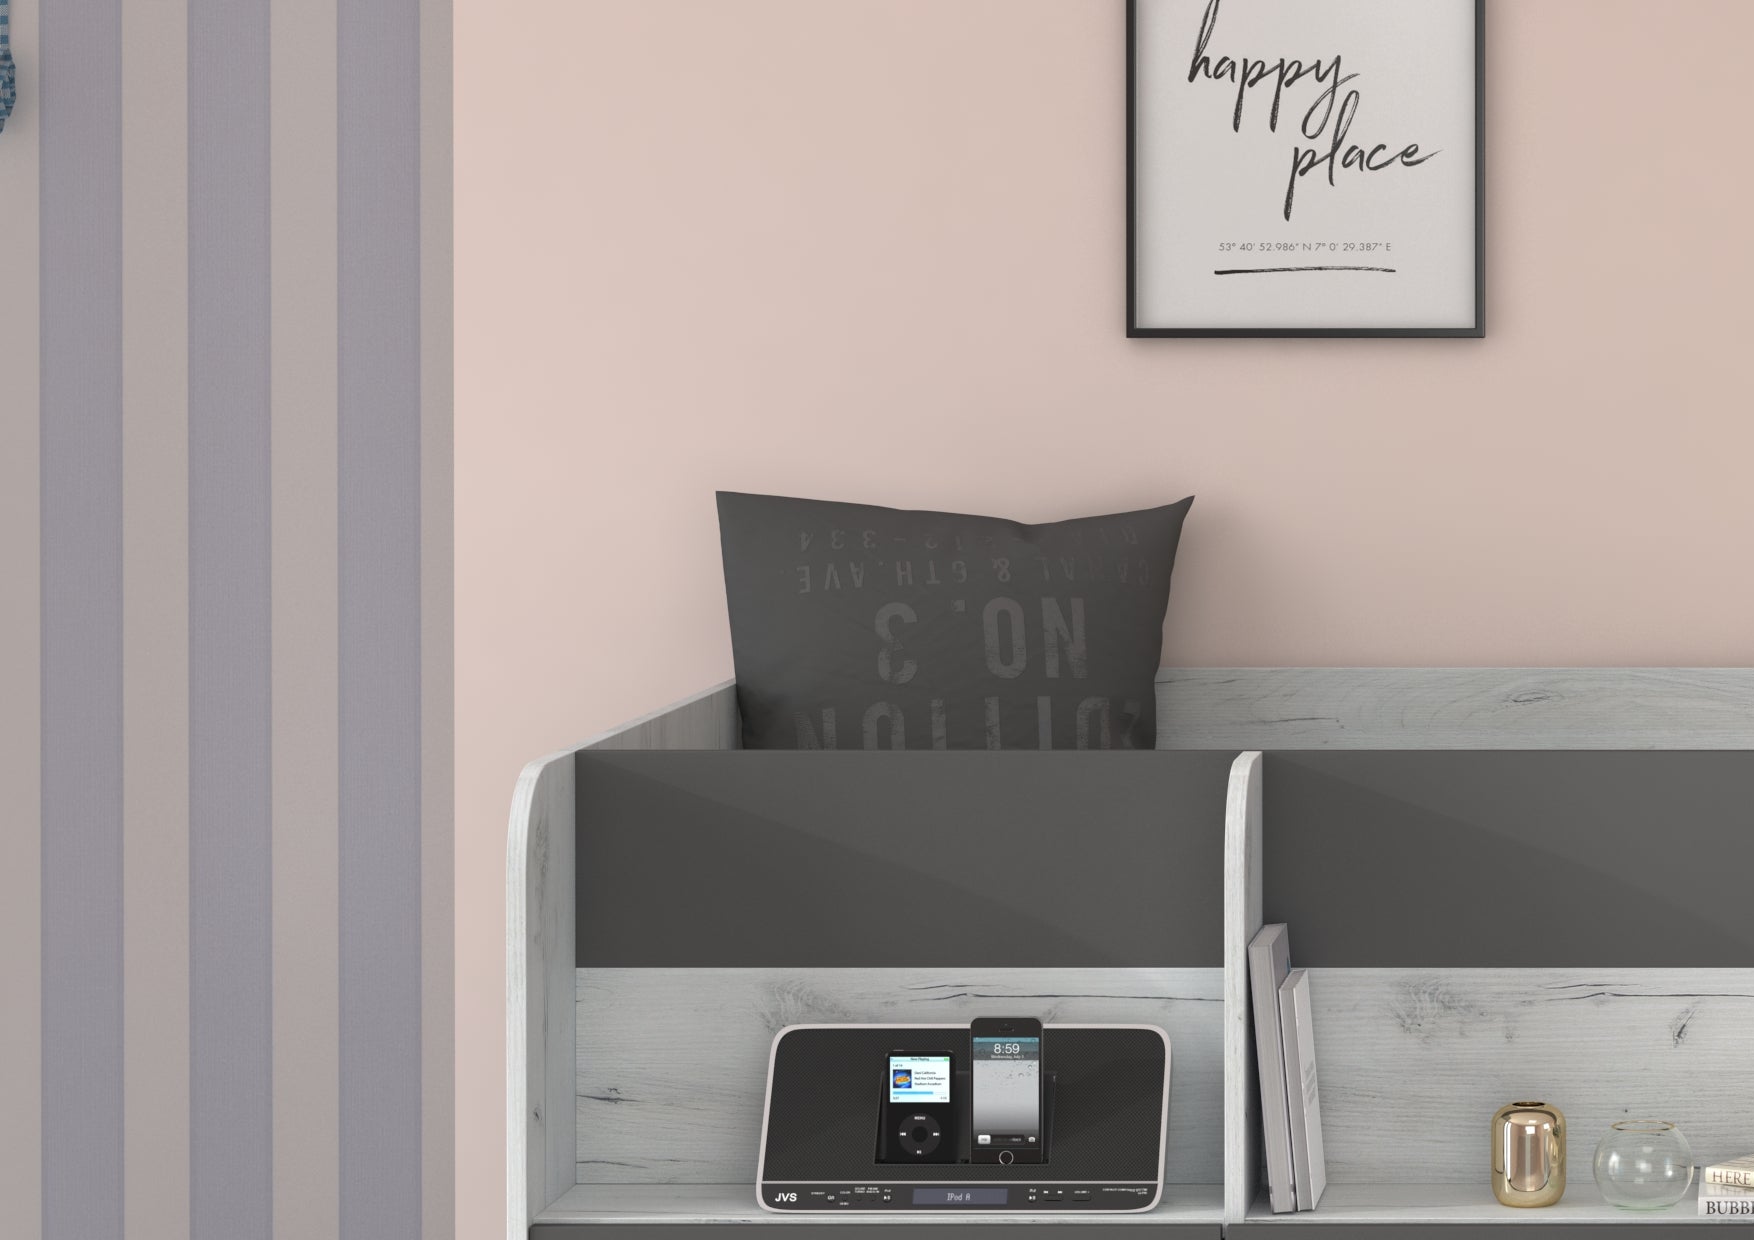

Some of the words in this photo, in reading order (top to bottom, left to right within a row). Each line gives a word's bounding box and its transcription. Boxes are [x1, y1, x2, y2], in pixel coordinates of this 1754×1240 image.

[1188, 0, 1360, 139] happy
[1284, 90, 1443, 221] place
[1303, 242, 1312, 251] N
[1386, 242, 1391, 251] E
[873, 601, 919, 685] 3
[951, 595, 1089, 681] NO.
[994, 1043, 1019, 1054] 8:59
[775, 1193, 797, 1202] JVS
[1713, 1171, 1750, 1185] HERE
